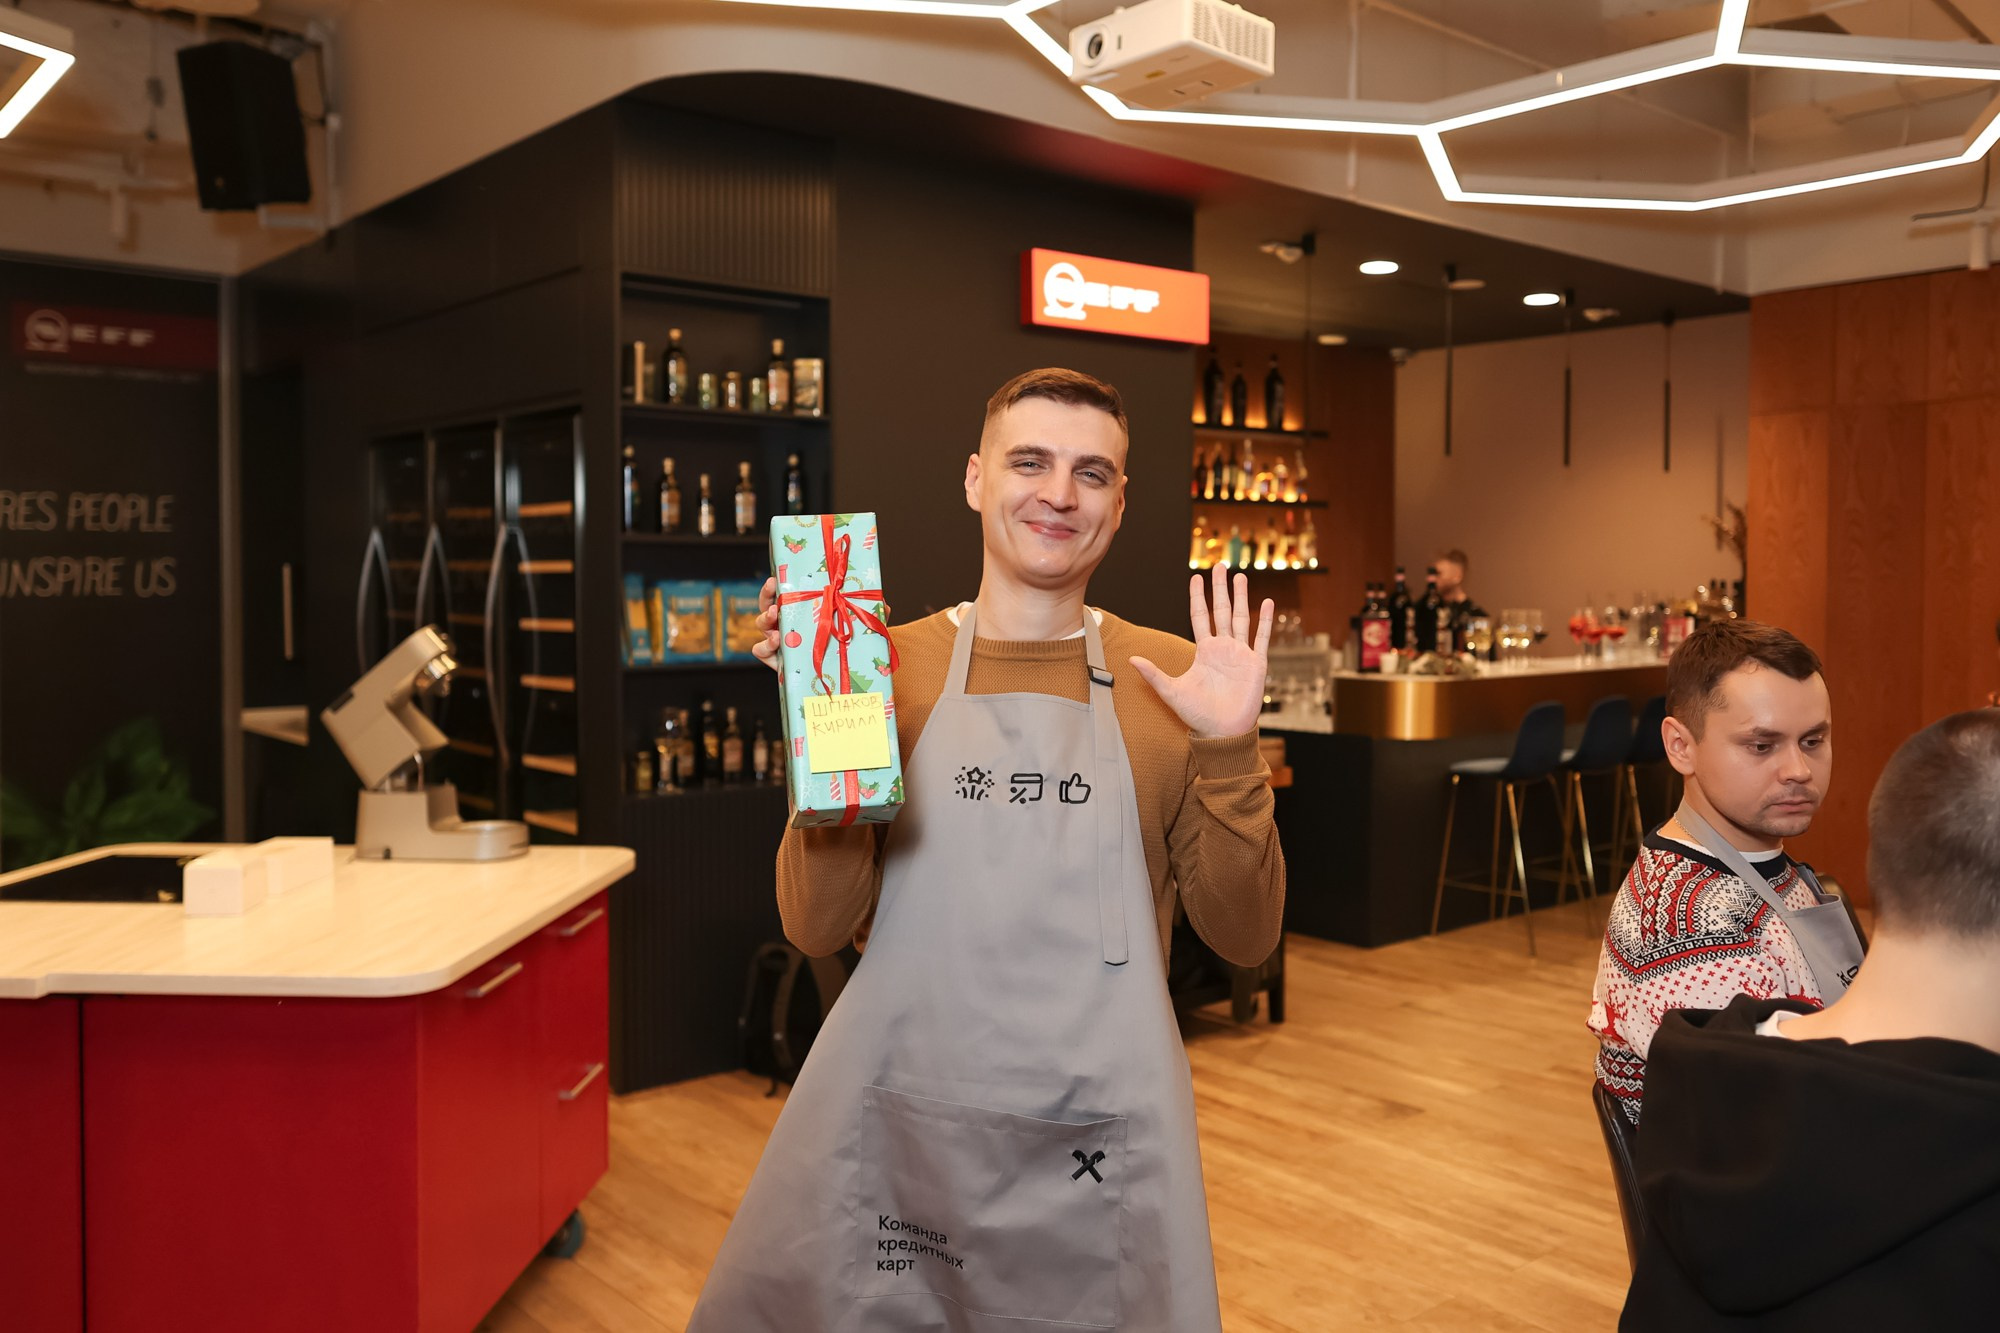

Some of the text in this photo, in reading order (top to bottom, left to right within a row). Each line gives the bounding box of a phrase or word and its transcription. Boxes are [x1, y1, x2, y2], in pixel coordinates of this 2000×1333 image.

[66, 492, 174, 532] PEOPLE
[134, 556, 177, 598] US
[812, 696, 882, 717] ШПАКОВ
[812, 714, 877, 737] КИРИЛЛ
[879, 1215, 947, 1244] Команда
[877, 1259, 915, 1276] карт
[878, 1239, 964, 1269] кредитных
